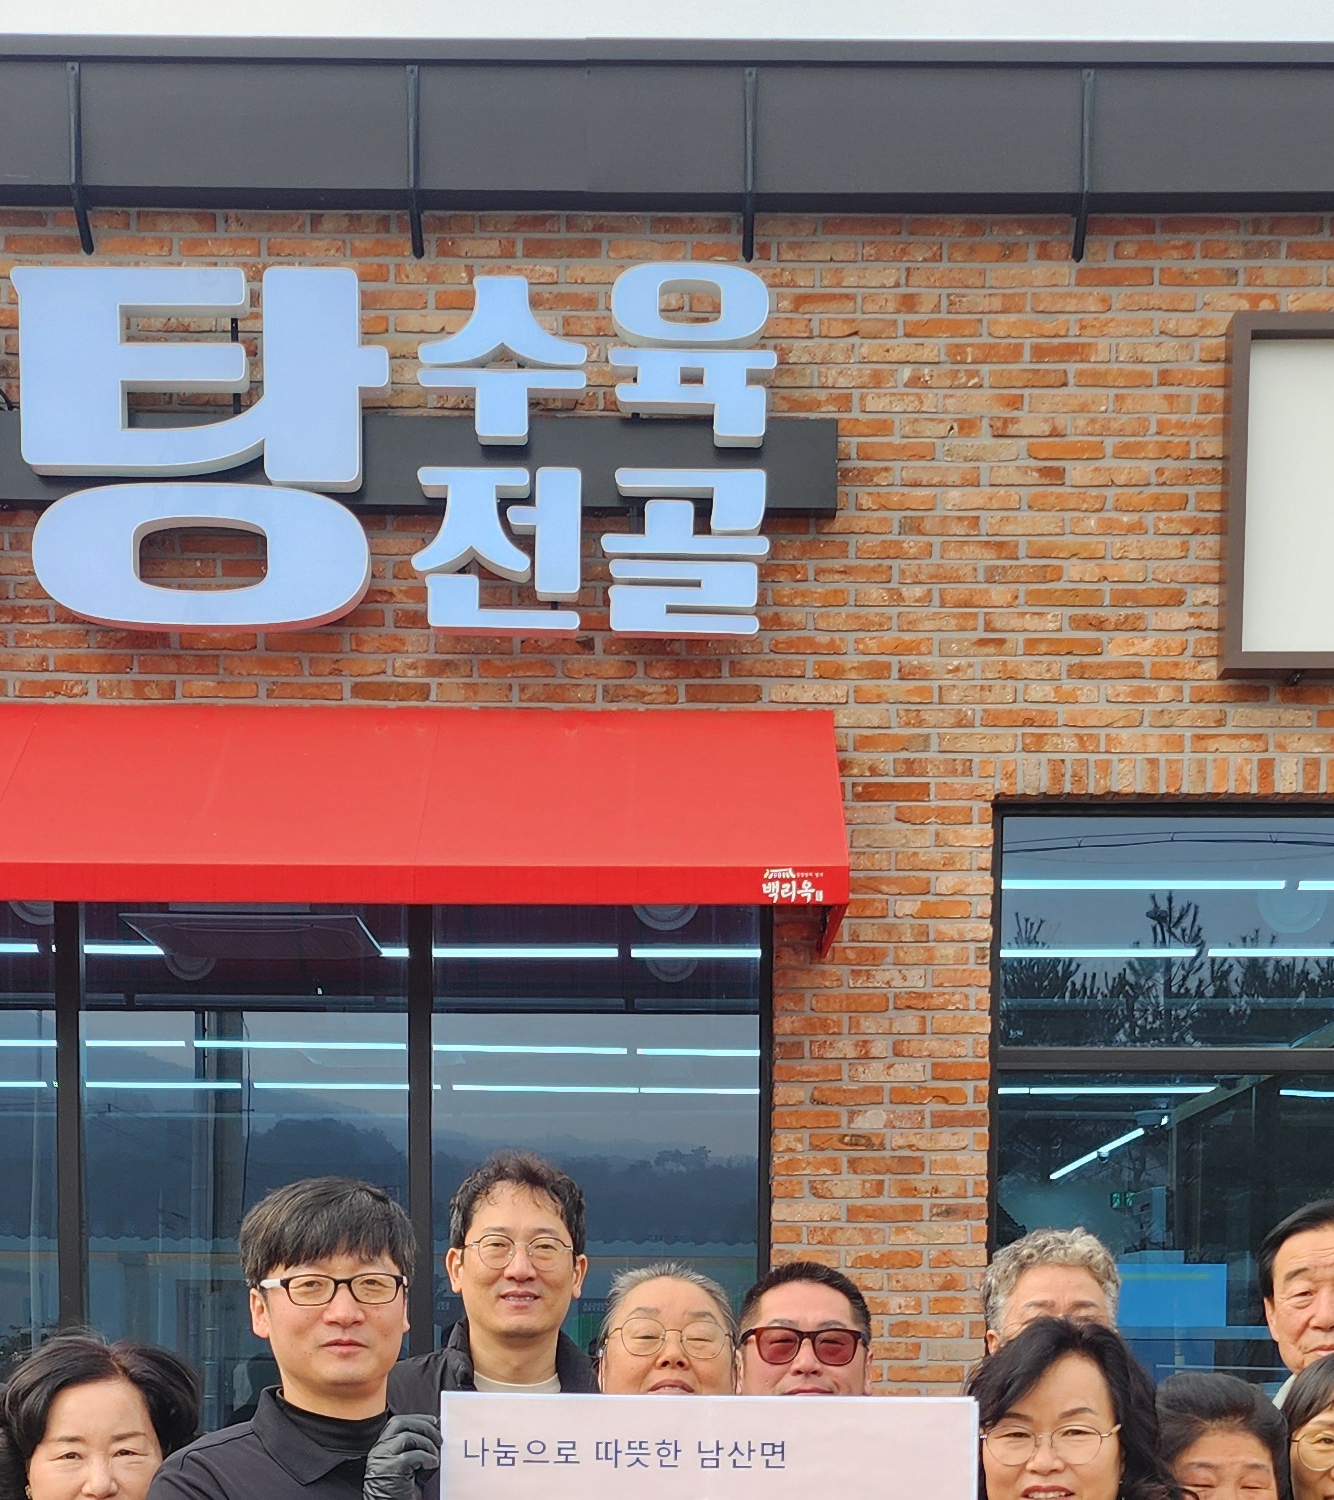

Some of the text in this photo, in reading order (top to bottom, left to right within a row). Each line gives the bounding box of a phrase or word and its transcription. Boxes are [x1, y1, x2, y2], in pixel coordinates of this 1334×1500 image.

[417, 261, 777, 449] 수육
[410, 465, 770, 640] 전골
[761, 879, 816, 904] 백리옥
[463, 1437, 788, 1470] 나눔으로 따뜻한 남산면
